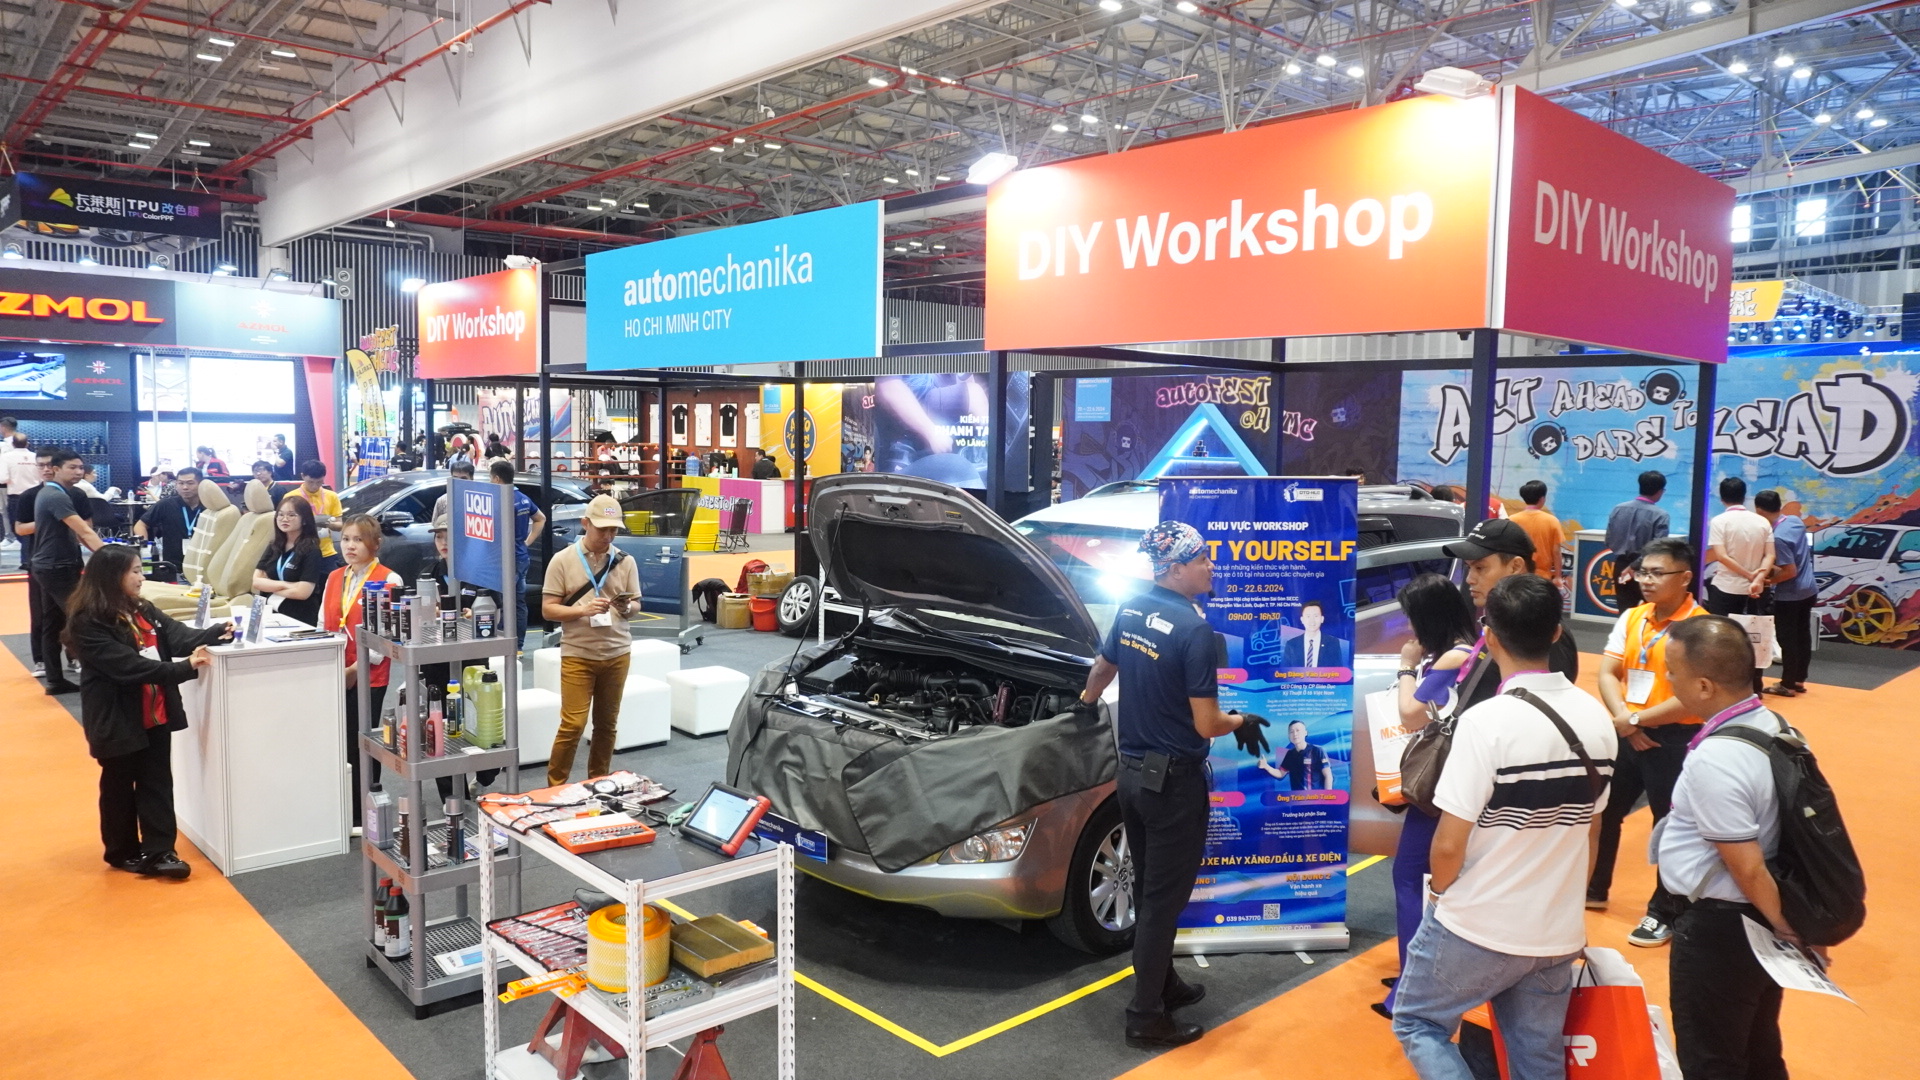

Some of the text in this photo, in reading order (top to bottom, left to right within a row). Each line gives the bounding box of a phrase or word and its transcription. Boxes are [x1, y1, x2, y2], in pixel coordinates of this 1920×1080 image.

[75, 193, 120, 209] 卡莱斯
[76, 206, 120, 216] CARLAS
[126, 200, 200, 218] TPU 改色膜
[1018, 188, 1434, 280] DIY Workshop
[1535, 180, 1718, 304] DIY Workshop
[624, 244, 813, 306] automechanika
[0, 291, 164, 323] ZMOL
[427, 308, 525, 343] DIY Workshop
[625, 308, 732, 338] HO CHI MINH CITY
[1549, 380, 1646, 418] AHEAD
[934, 425, 989, 436] PHANH TA
[1240, 406, 1318, 441] @HMC
[1572, 370, 1911, 477] DARE LEAD
[466, 494, 491, 516] LIQUI
[466, 516, 492, 538] MOLY
[1208, 522, 1228, 530] KHU
[1253, 522, 1308, 530] WORKSHOP
[1206, 540, 1356, 561] T YOURSELF
[1244, 584, 1284, 592] 22.6.2024
[1148, 648, 1159, 660] Day
[1275, 670, 1287, 678] Ông
[1277, 794, 1289, 802] Ông
[1208, 857, 1220, 866] XE
[1222, 854, 1242, 865] MÁY
[1306, 854, 1317, 862] XE
[1320, 851, 1341, 863] ĐIỆN
